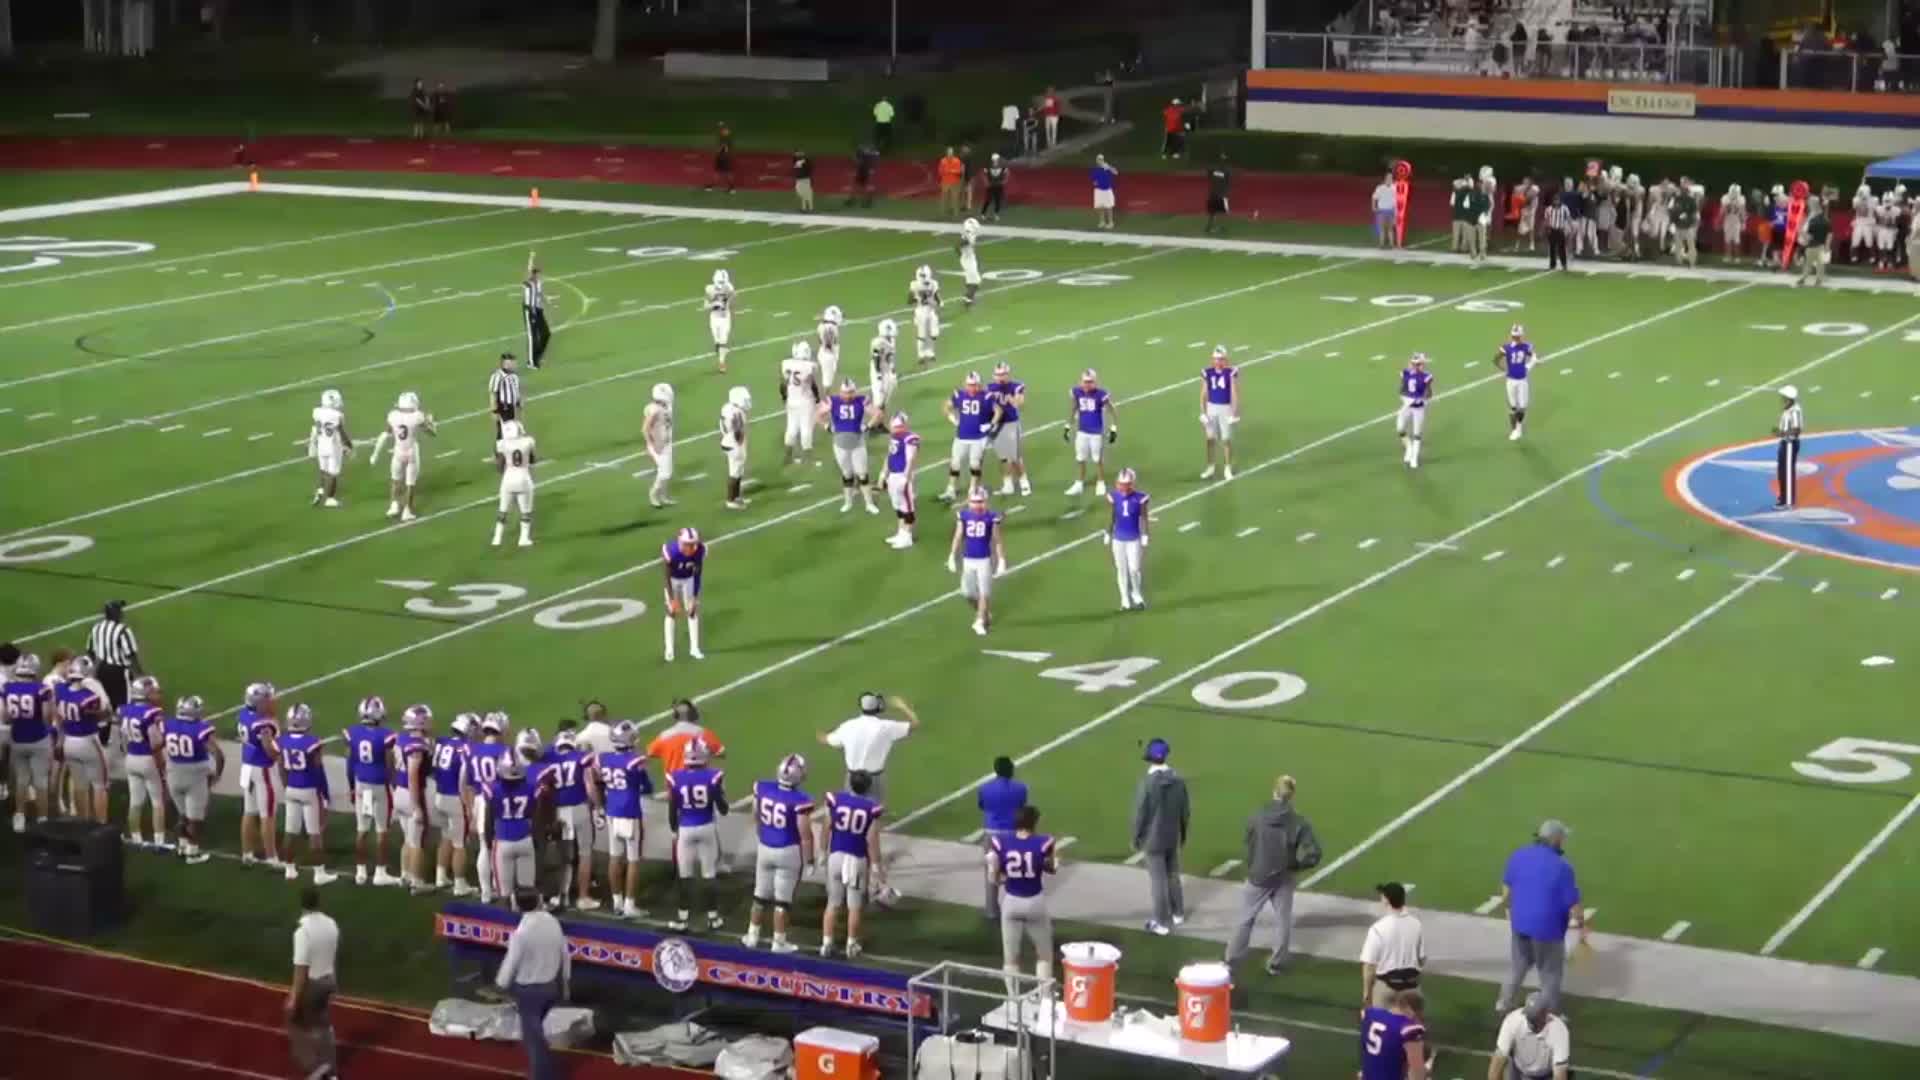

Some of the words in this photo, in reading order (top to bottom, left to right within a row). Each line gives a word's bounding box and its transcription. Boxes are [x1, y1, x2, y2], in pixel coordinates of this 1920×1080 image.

[1211, 375, 1226, 389] 14
[839, 404, 855, 420] 51
[962, 399, 980, 415] 50
[398, 419, 408, 441] 3
[1121, 500, 1130, 517] 1
[7, 694, 35, 719] 69
[165, 734, 193, 757] 60
[359, 740, 373, 764] 8
[282, 748, 307, 770] 13
[471, 756, 496, 782] 10
[502, 796, 528, 819] 17
[680, 785, 708, 809] 19
[760, 797, 787, 829] 56
[835, 806, 867, 834] 30
[1005, 850, 1034, 878] 21
[1071, 976, 1087, 992] G
[1366, 1021, 1387, 1056] 5
[818, 1053, 836, 1074] G
